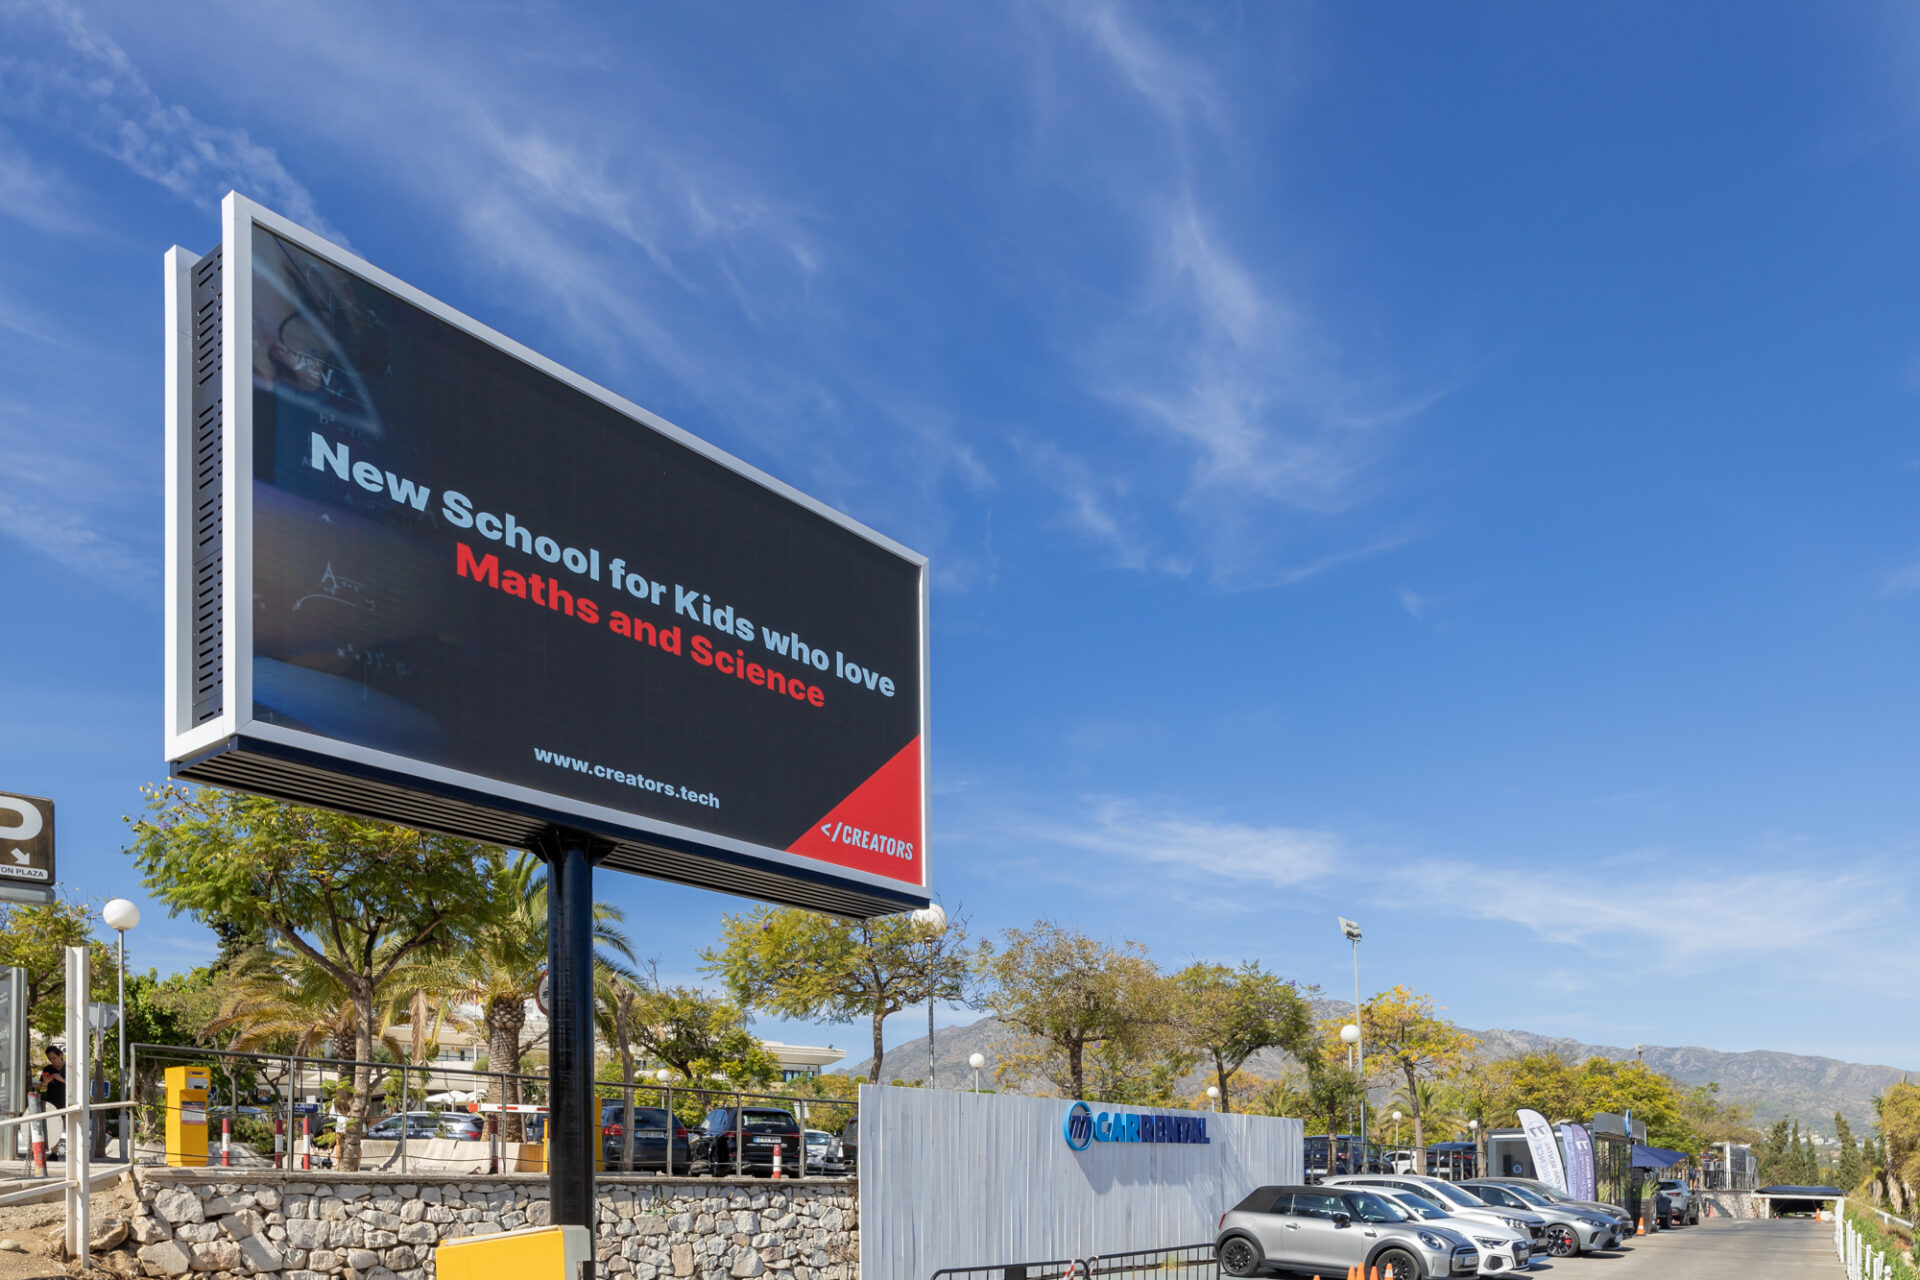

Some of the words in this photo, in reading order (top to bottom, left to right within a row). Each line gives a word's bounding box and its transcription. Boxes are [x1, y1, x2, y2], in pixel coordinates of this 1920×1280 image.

[311, 431, 431, 512] New
[441, 490, 600, 582] School
[608, 558, 667, 606] for
[674, 583, 755, 642] Kids
[761, 626, 830, 671] who
[836, 650, 896, 698] love
[456, 541, 600, 625] Maths
[609, 610, 682, 657] and
[690, 634, 825, 708] Science
[533, 747, 720, 809] www.creators.tech
[0, 866, 14, 874] ON
[16, 868, 44, 877] PLAZA
